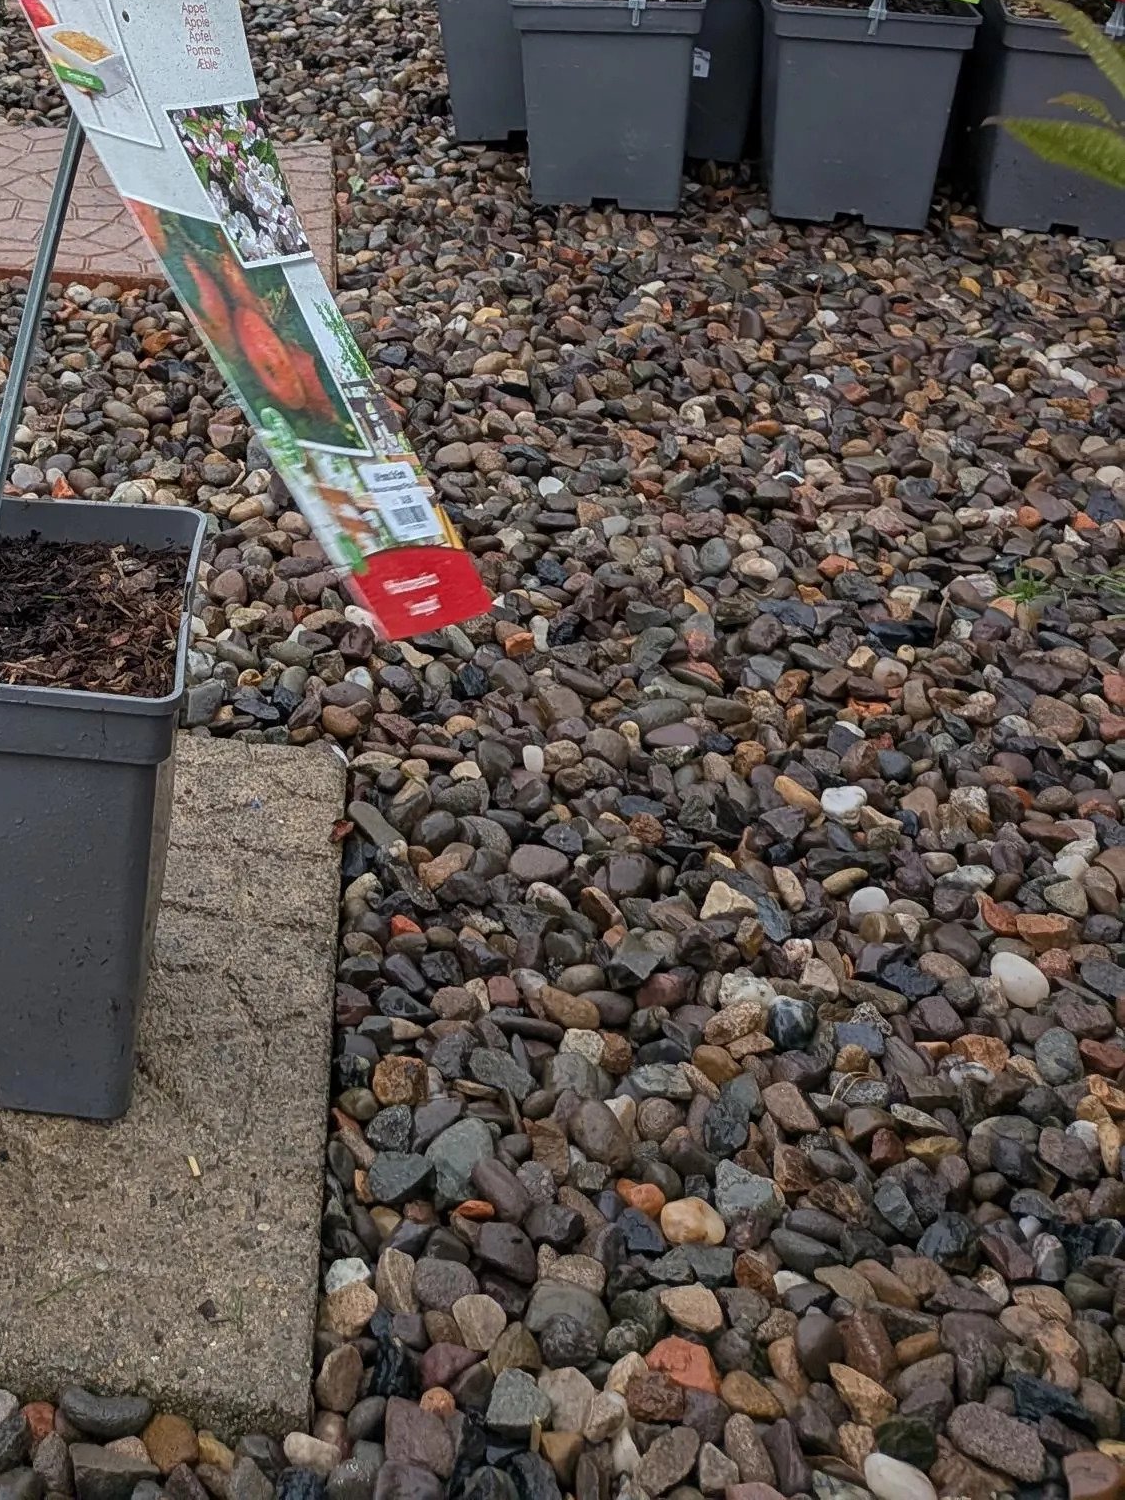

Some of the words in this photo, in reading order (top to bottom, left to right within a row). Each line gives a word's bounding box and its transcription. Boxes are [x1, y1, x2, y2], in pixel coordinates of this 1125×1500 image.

[181, 2, 207, 16] Appel
[185, 15, 210, 31] Apple
[186, 44, 221, 56] Pomme
